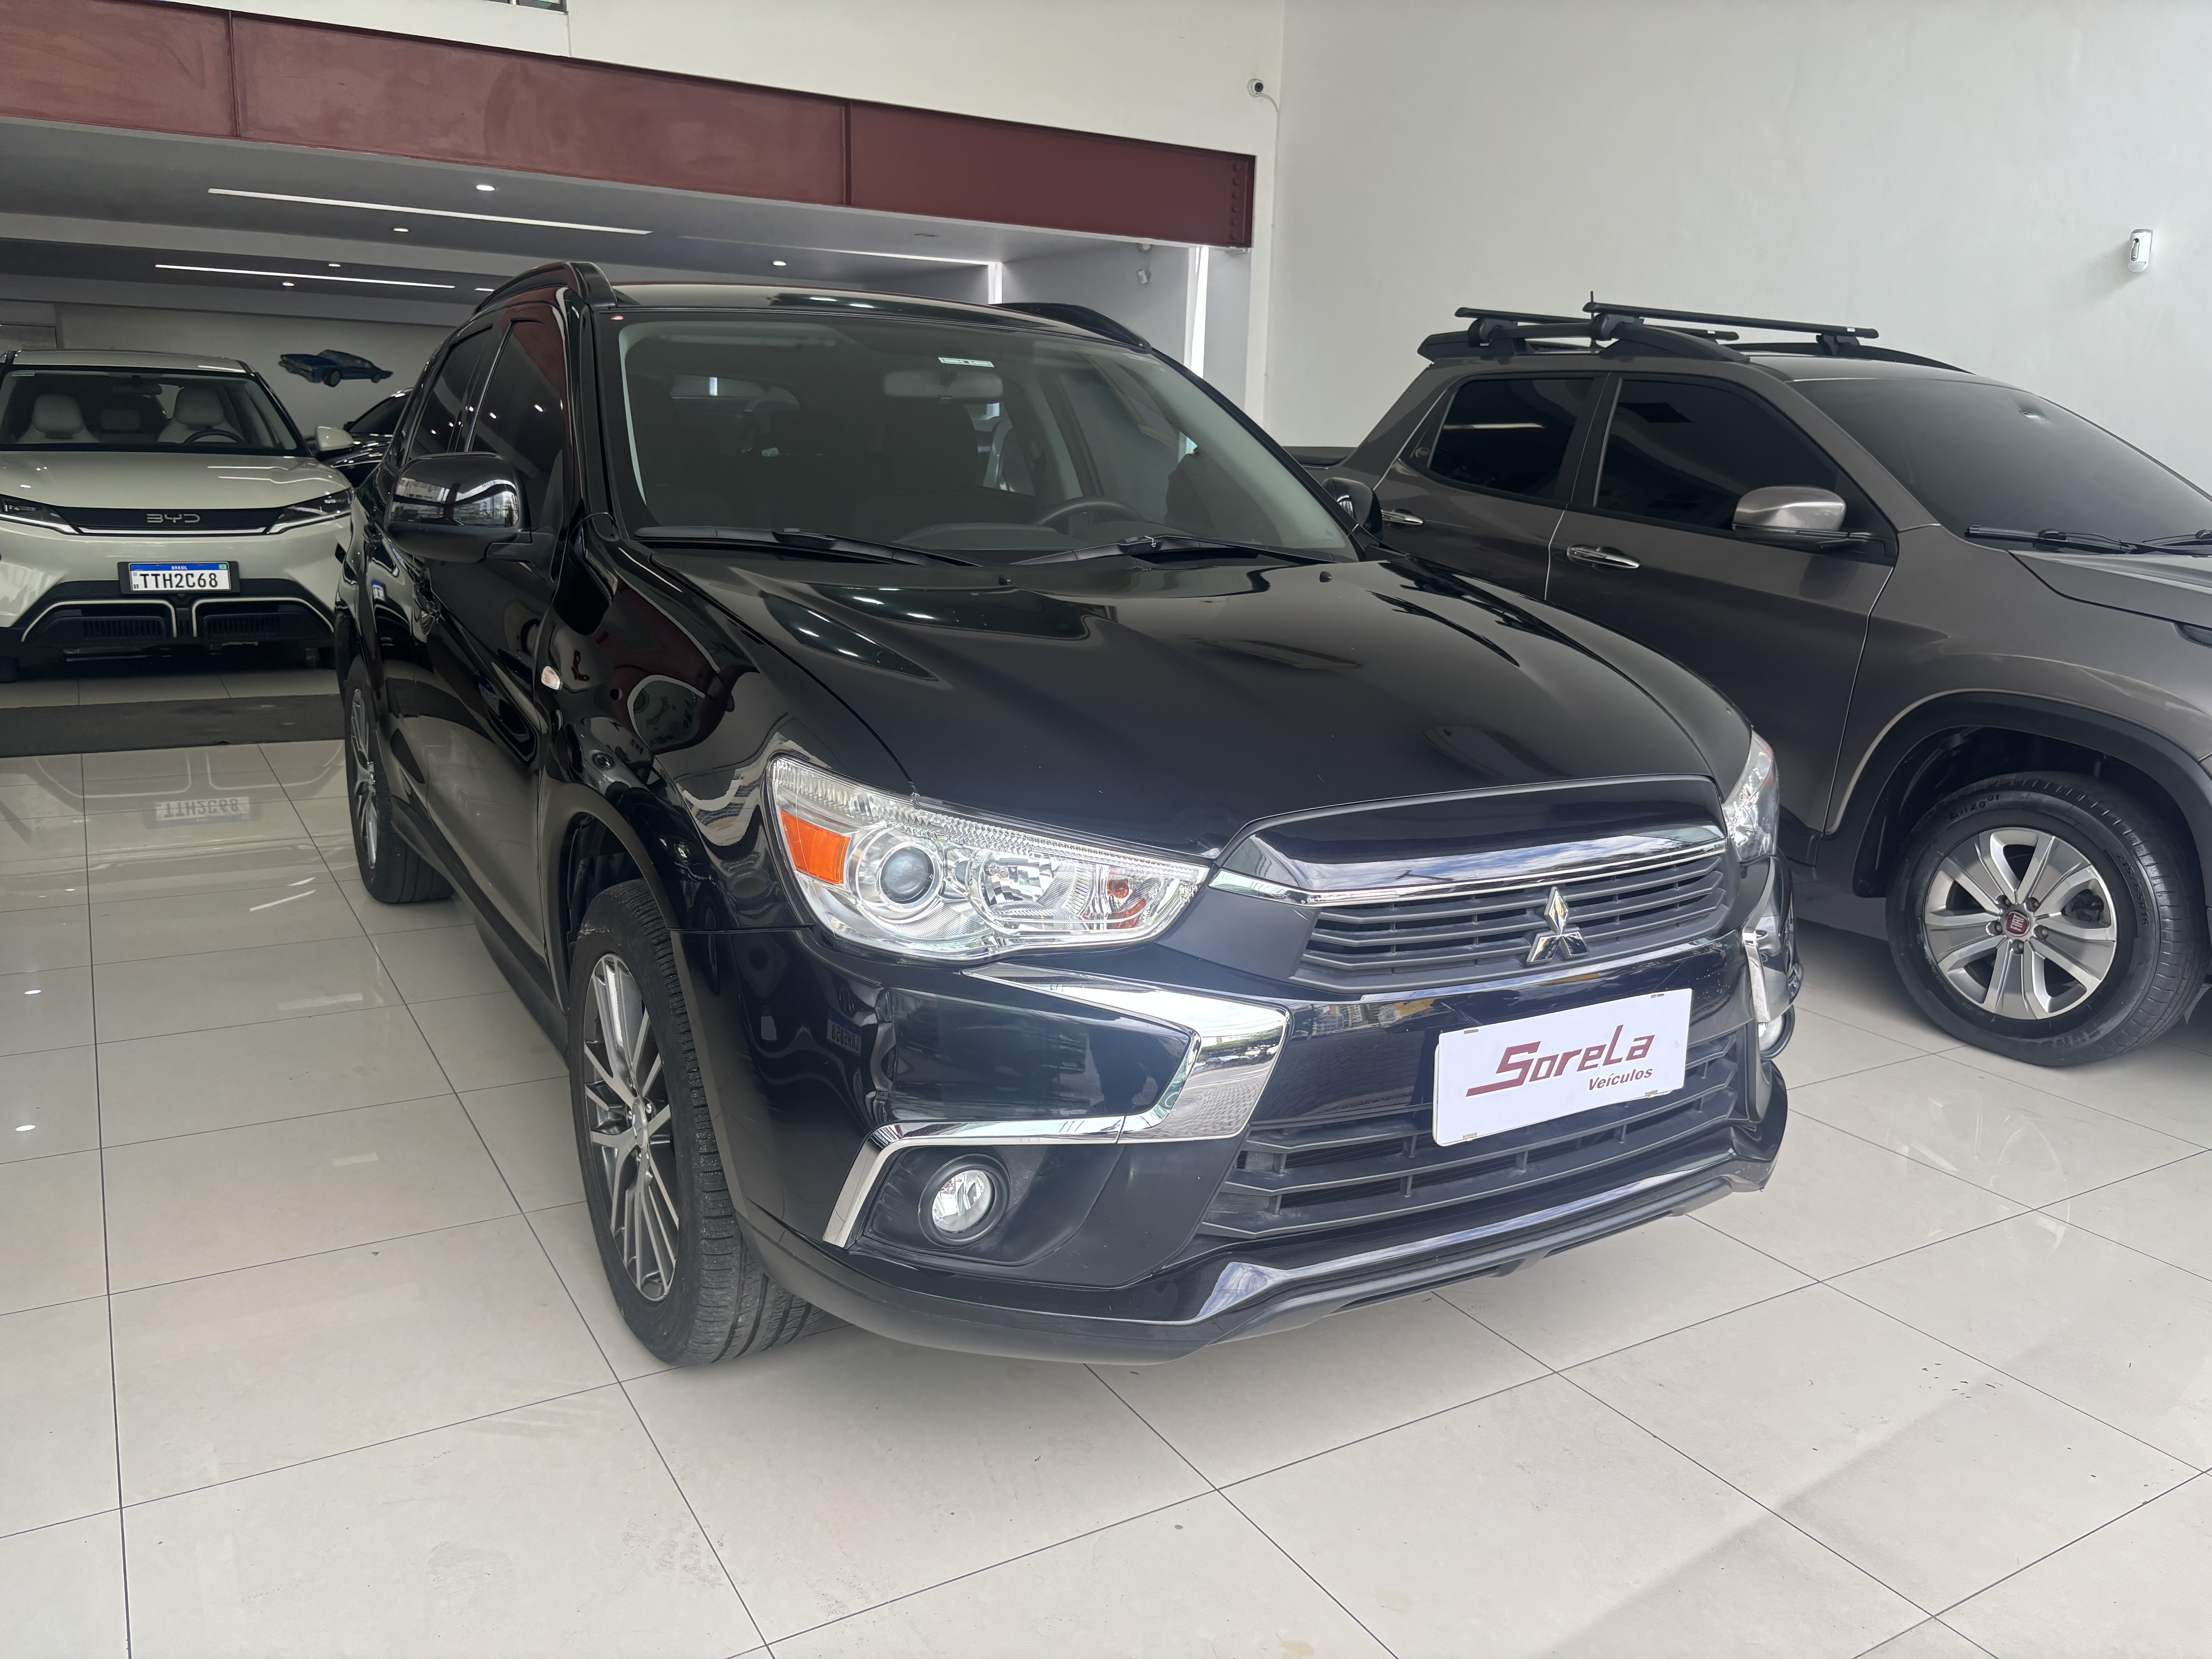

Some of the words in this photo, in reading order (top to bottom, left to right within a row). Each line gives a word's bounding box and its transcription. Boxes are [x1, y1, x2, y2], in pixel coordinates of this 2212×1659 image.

[146, 514, 200, 523] BYD
[140, 572, 218, 589] TTH2C68
[2010, 914, 2025, 931] FIAT
[1589, 1068, 1653, 1091] Veículos
